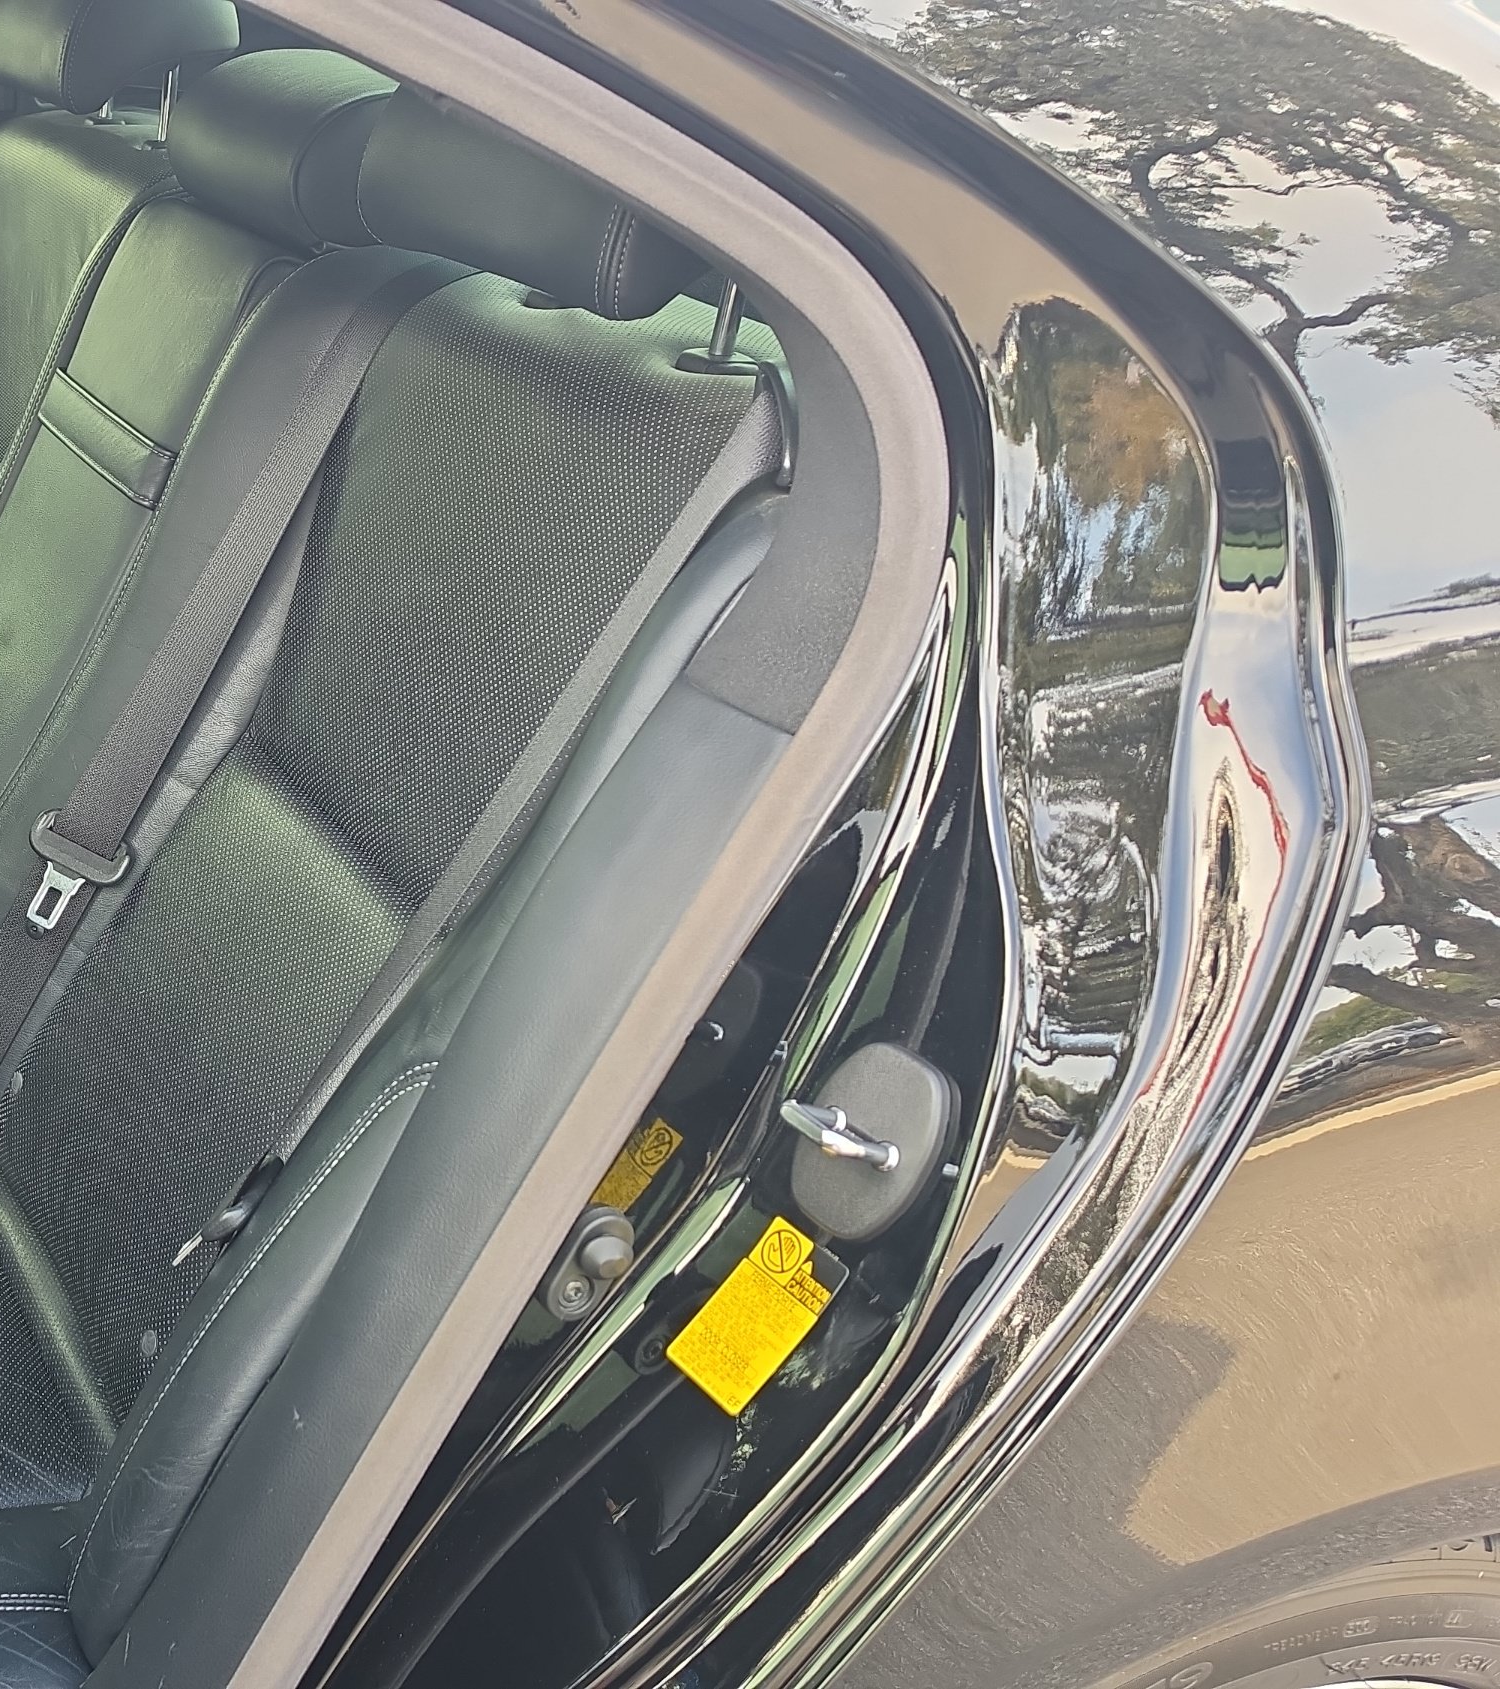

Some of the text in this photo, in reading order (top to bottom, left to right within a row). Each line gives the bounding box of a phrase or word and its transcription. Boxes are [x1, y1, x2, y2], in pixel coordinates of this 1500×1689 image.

[785, 1280, 823, 1315] CAUTION
[792, 1269, 832, 1303] ATTENTION
[719, 1344, 750, 1373] CLOSER
